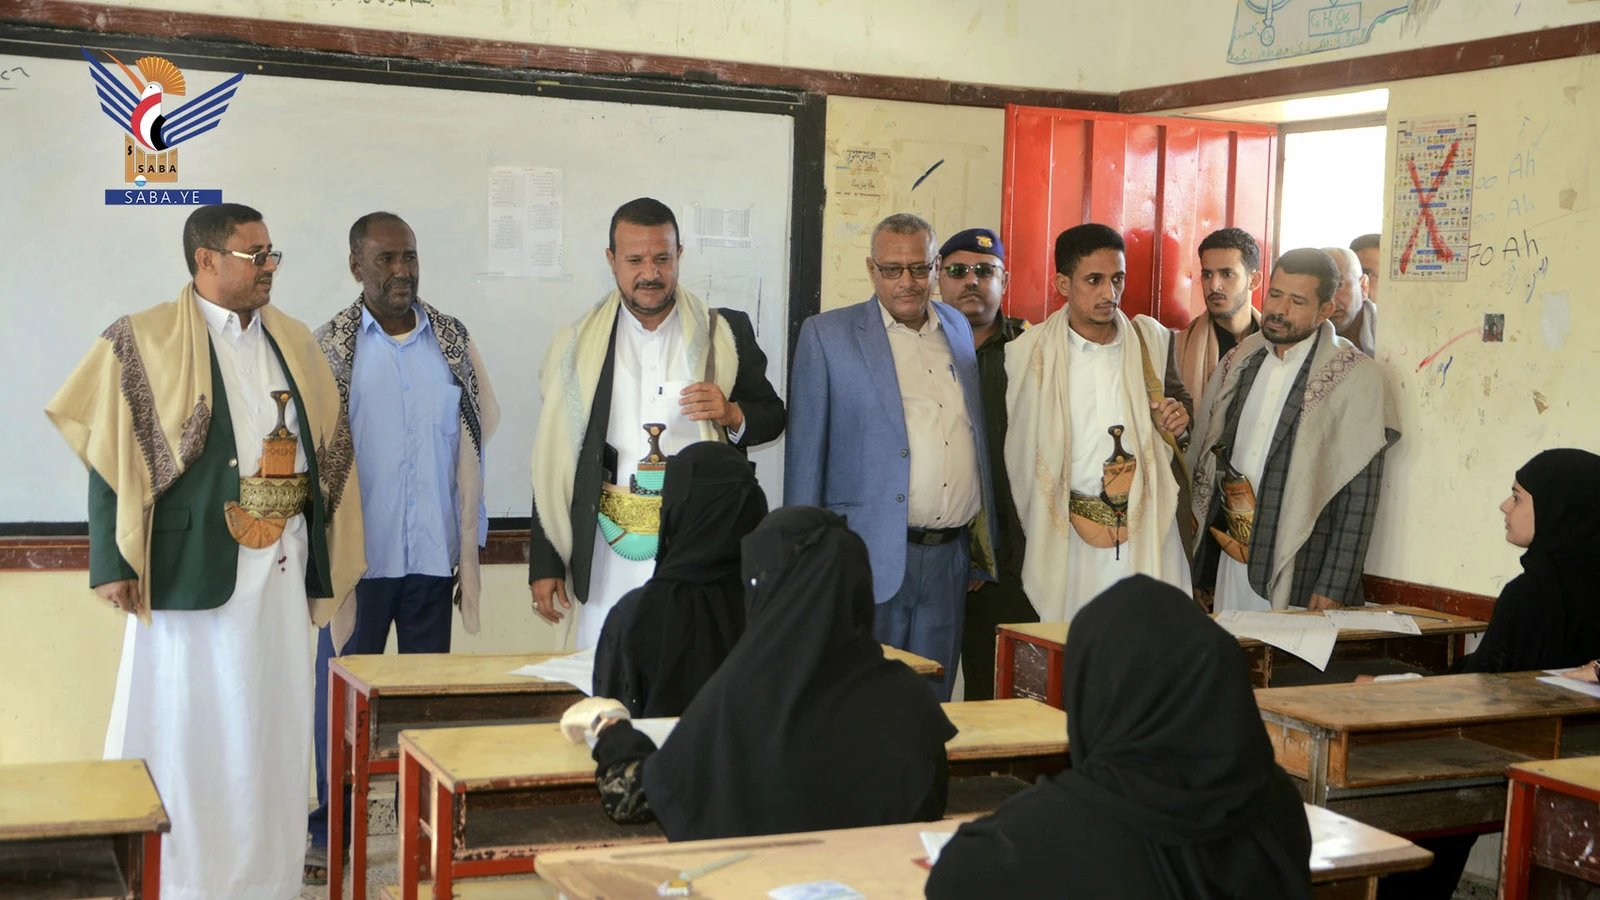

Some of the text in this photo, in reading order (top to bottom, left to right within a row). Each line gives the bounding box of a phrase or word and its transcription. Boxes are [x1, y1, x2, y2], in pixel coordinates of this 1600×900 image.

[1508, 149, 1536, 185] Ah
[1507, 192, 1535, 218] Ah
[1502, 228, 1539, 262] Ah
